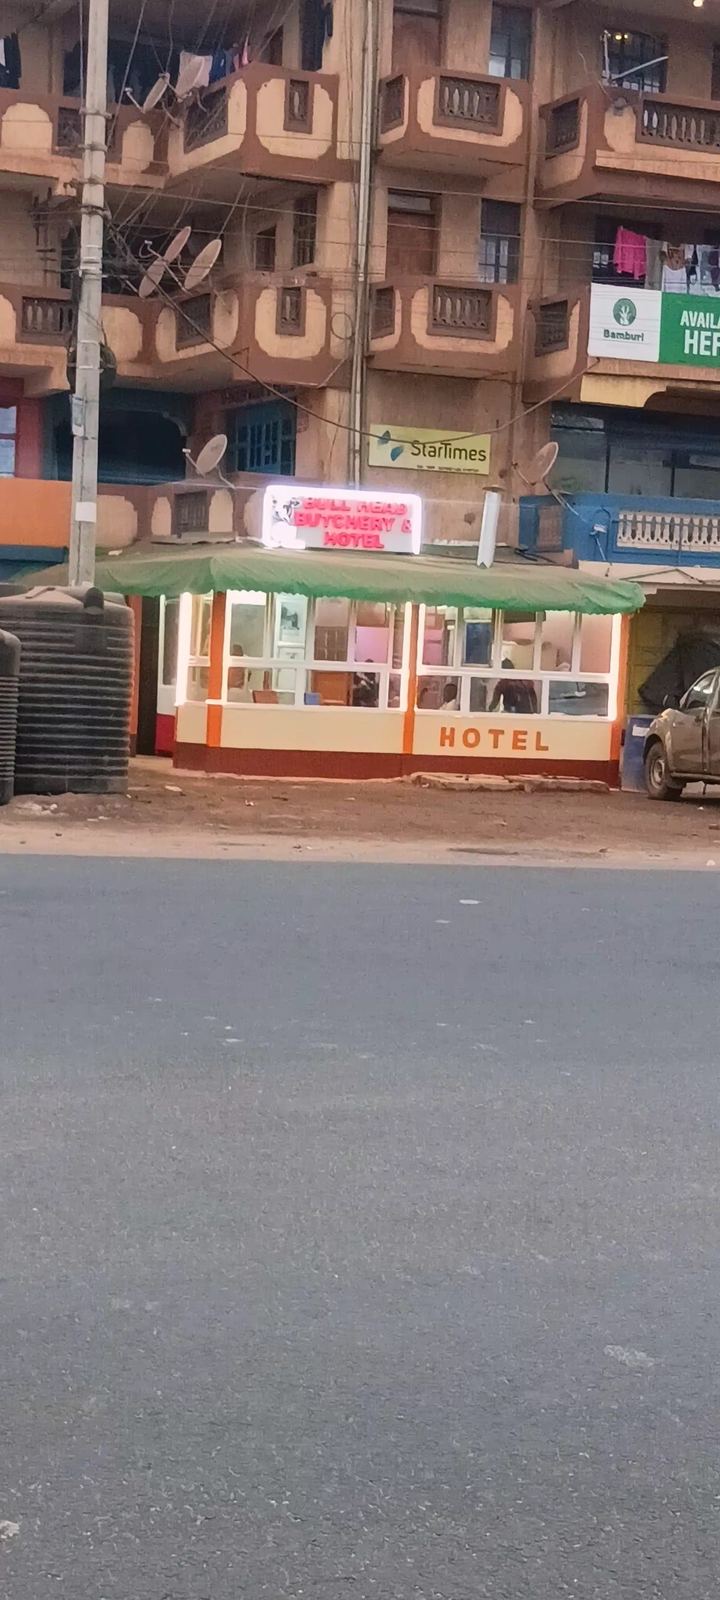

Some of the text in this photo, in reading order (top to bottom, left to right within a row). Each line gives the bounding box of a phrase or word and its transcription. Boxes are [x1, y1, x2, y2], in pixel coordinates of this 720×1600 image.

[603, 329, 645, 342] Bamburi
[411, 440, 487, 462] StarTimes
[303, 497, 408, 515] BULL HEAD
[294, 511, 412, 534] BUTCHERY &
[323, 531, 385, 549] HOTEL
[439, 726, 550, 751] HOTEL
